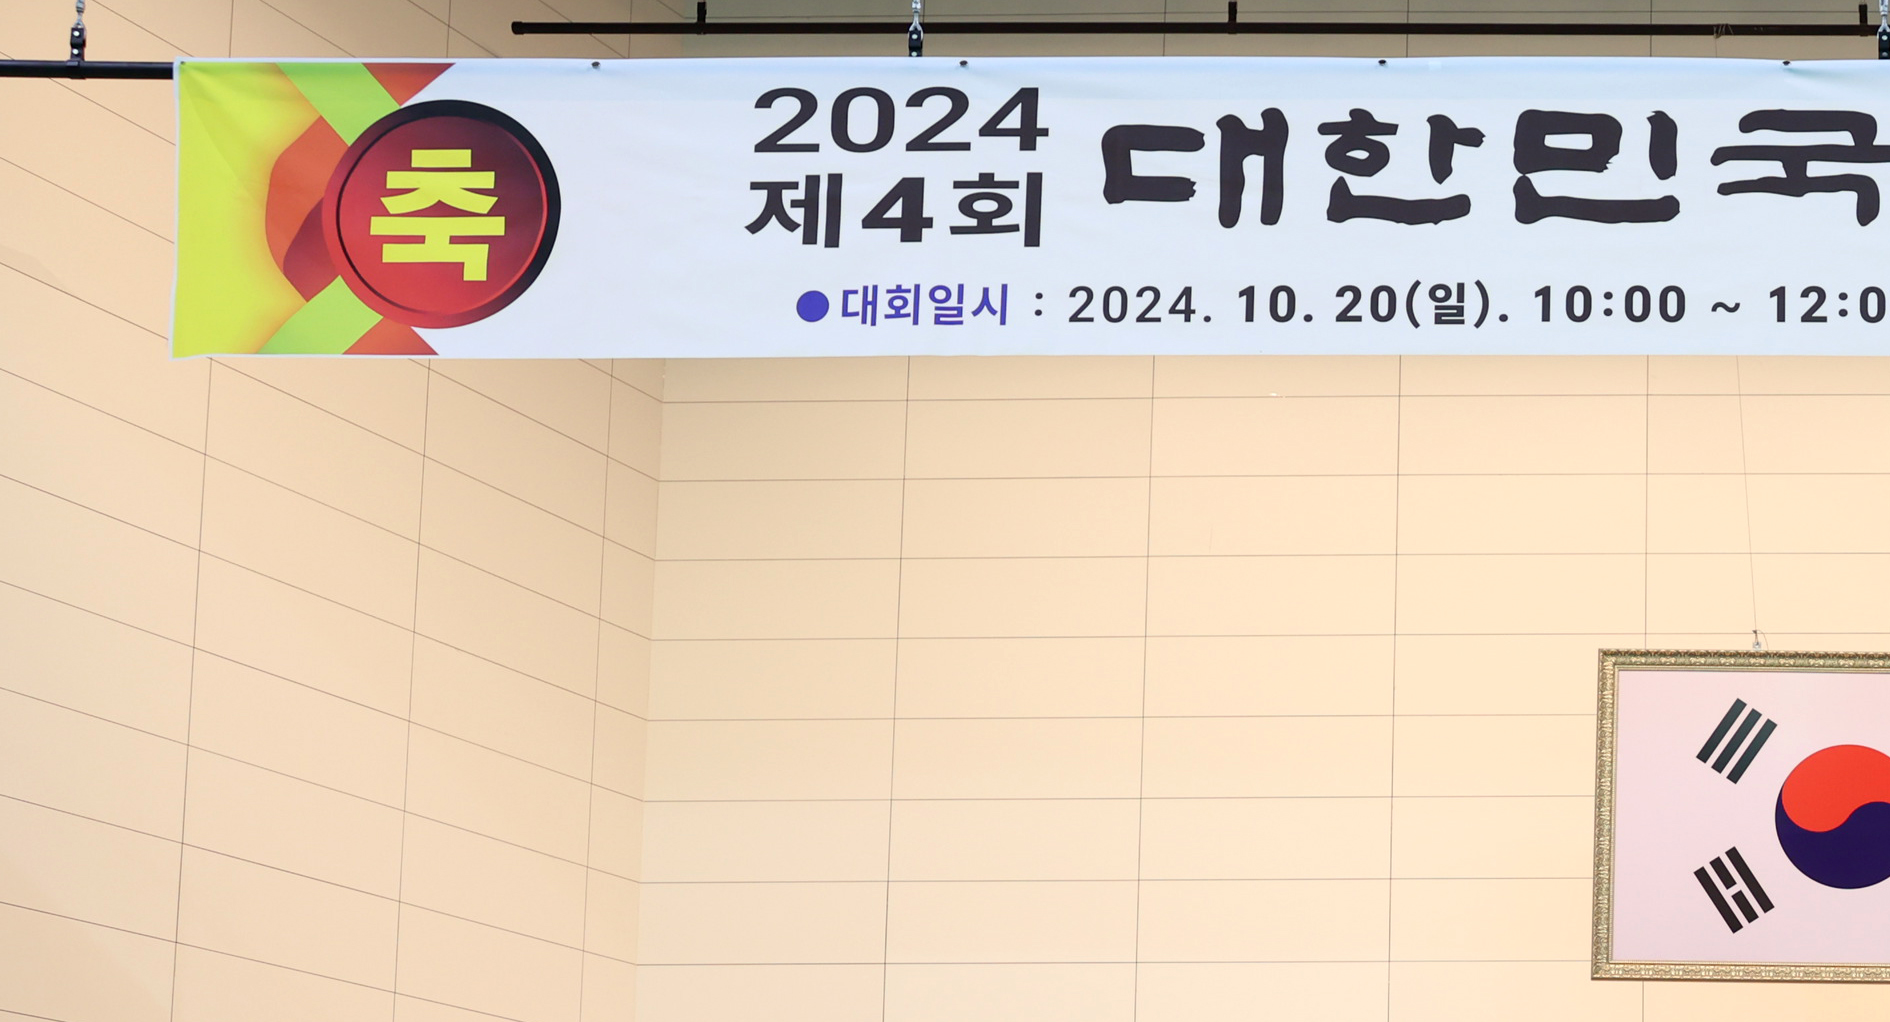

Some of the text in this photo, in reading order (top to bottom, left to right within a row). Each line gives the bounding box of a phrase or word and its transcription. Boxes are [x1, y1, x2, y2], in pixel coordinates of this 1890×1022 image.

[753, 85, 1050, 154] 2024
[369, 148, 507, 283] 축
[743, 171, 1044, 249] 제4회
[841, 283, 1009, 327] 대회일시
[1068, 285, 1212, 324] 2024.
[1238, 284, 1314, 324] 10.
[1335, 279, 1509, 330] 20(일).
[1534, 284, 1686, 324] 10:00
